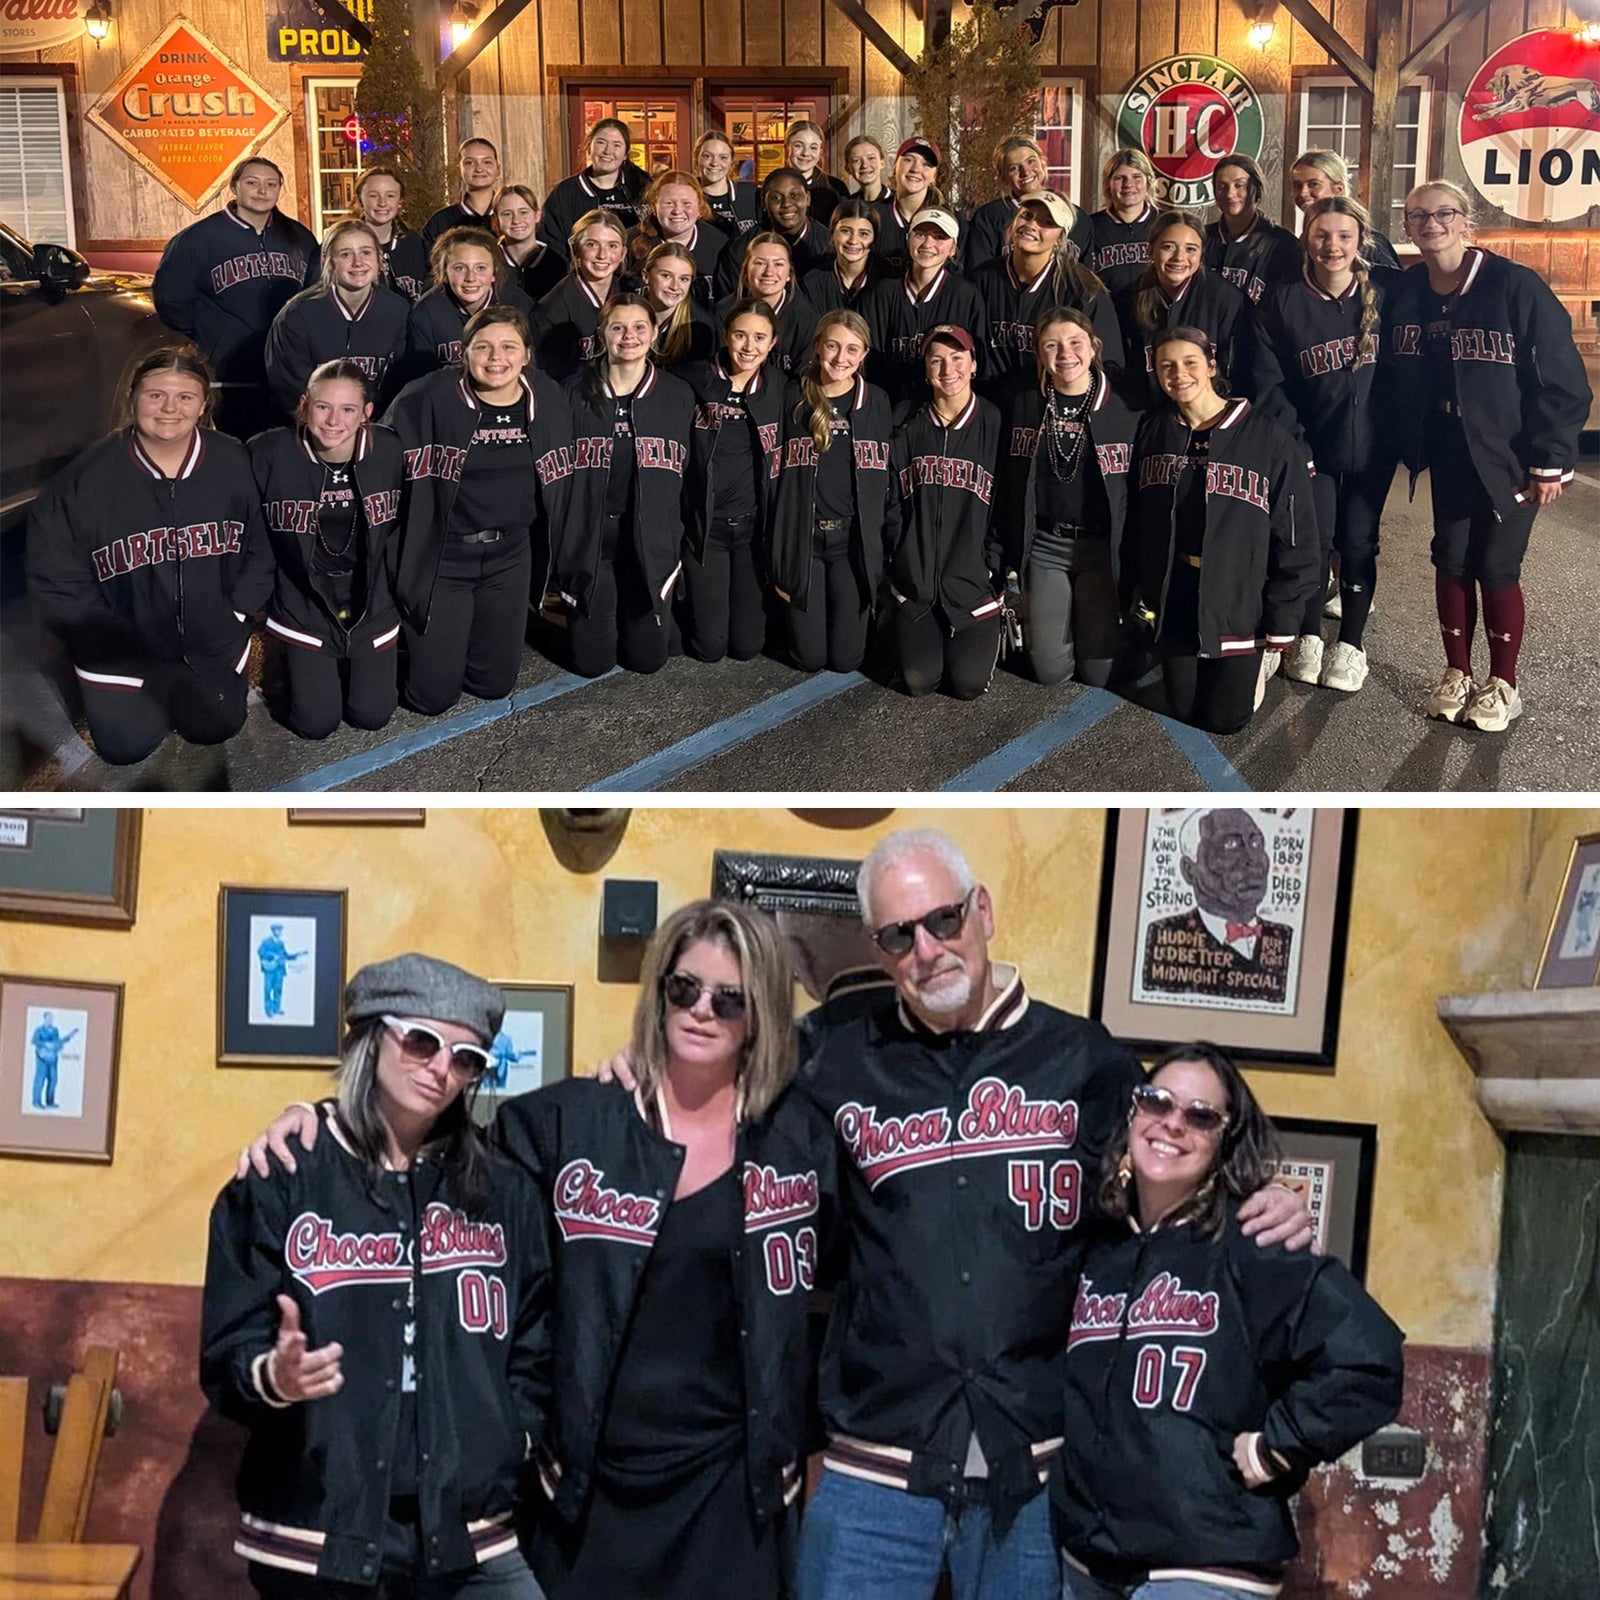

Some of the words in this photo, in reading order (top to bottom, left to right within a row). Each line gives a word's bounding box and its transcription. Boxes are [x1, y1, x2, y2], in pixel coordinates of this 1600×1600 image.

[0, 0, 78, 20] alue
[2, 28, 36, 37] STORES
[279, 29, 361, 56] PROD
[159, 53, 207, 63] DRINK
[1127, 60, 1253, 115] SINCLAIR
[122, 83, 256, 122] Crush
[122, 128, 195, 138] CARBONATED
[198, 128, 257, 137] BEVERAGE
[159, 143, 193, 151] NATURAL
[196, 143, 224, 151] FLAVOR
[161, 155, 193, 163] NATURAL
[1157, 827, 1175, 837] THE
[1152, 839, 1177, 852] KING
[1273, 836, 1304, 850] BORN
[1156, 854, 1172, 864] OF
[1273, 851, 1303, 865] 1889
[1157, 865, 1176, 876] THE
[1153, 878, 1171, 891] 12
[1272, 875, 1301, 891] DIED
[1271, 892, 1301, 906] 1949
[1151, 964, 1220, 986] MIDNIGHT
[1227, 971, 1280, 989] SPECIAL
[958, 1076, 1079, 1144] Blues
[553, 1158, 660, 1231] Choca
[744, 1161, 819, 1222] Blues
[1008, 1159, 1082, 1231] 49
[285, 1211, 403, 1273] Choca
[420, 1202, 507, 1264] Blues
[763, 1227, 818, 1296] 03
[1128, 1271, 1219, 1331] Blues
[1132, 1344, 1207, 1412] 07
